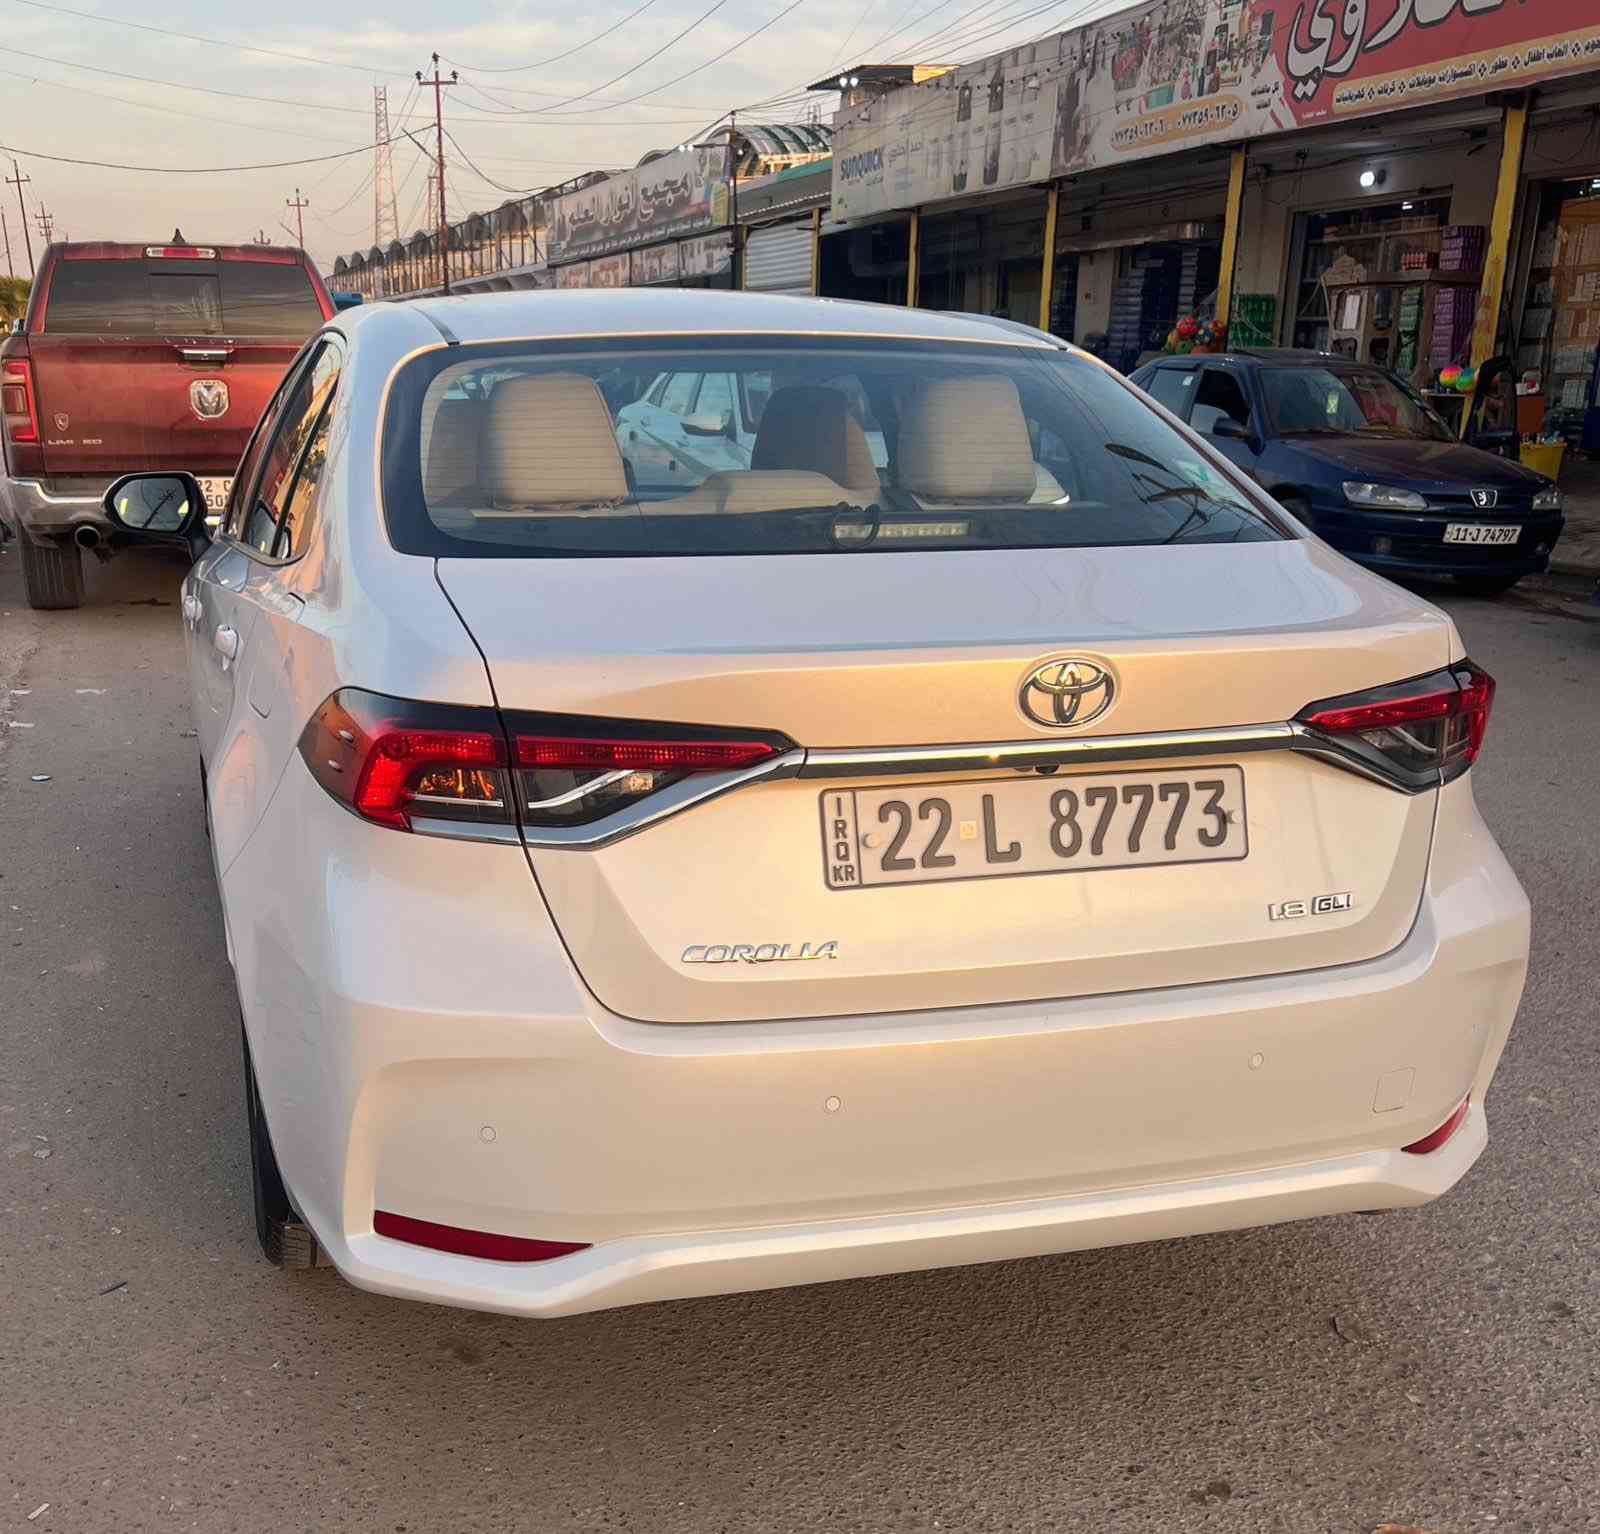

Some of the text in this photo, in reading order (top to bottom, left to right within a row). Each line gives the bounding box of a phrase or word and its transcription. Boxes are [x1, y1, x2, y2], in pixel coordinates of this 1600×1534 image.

[1453, 527, 1468, 541] 11
[1482, 528, 1518, 542] 74797
[878, 779, 1228, 872] 22 L 87773
[832, 864, 856, 882] KR
[1267, 893, 1351, 920] 1.8 GLI
[681, 940, 839, 964] COROLLA
